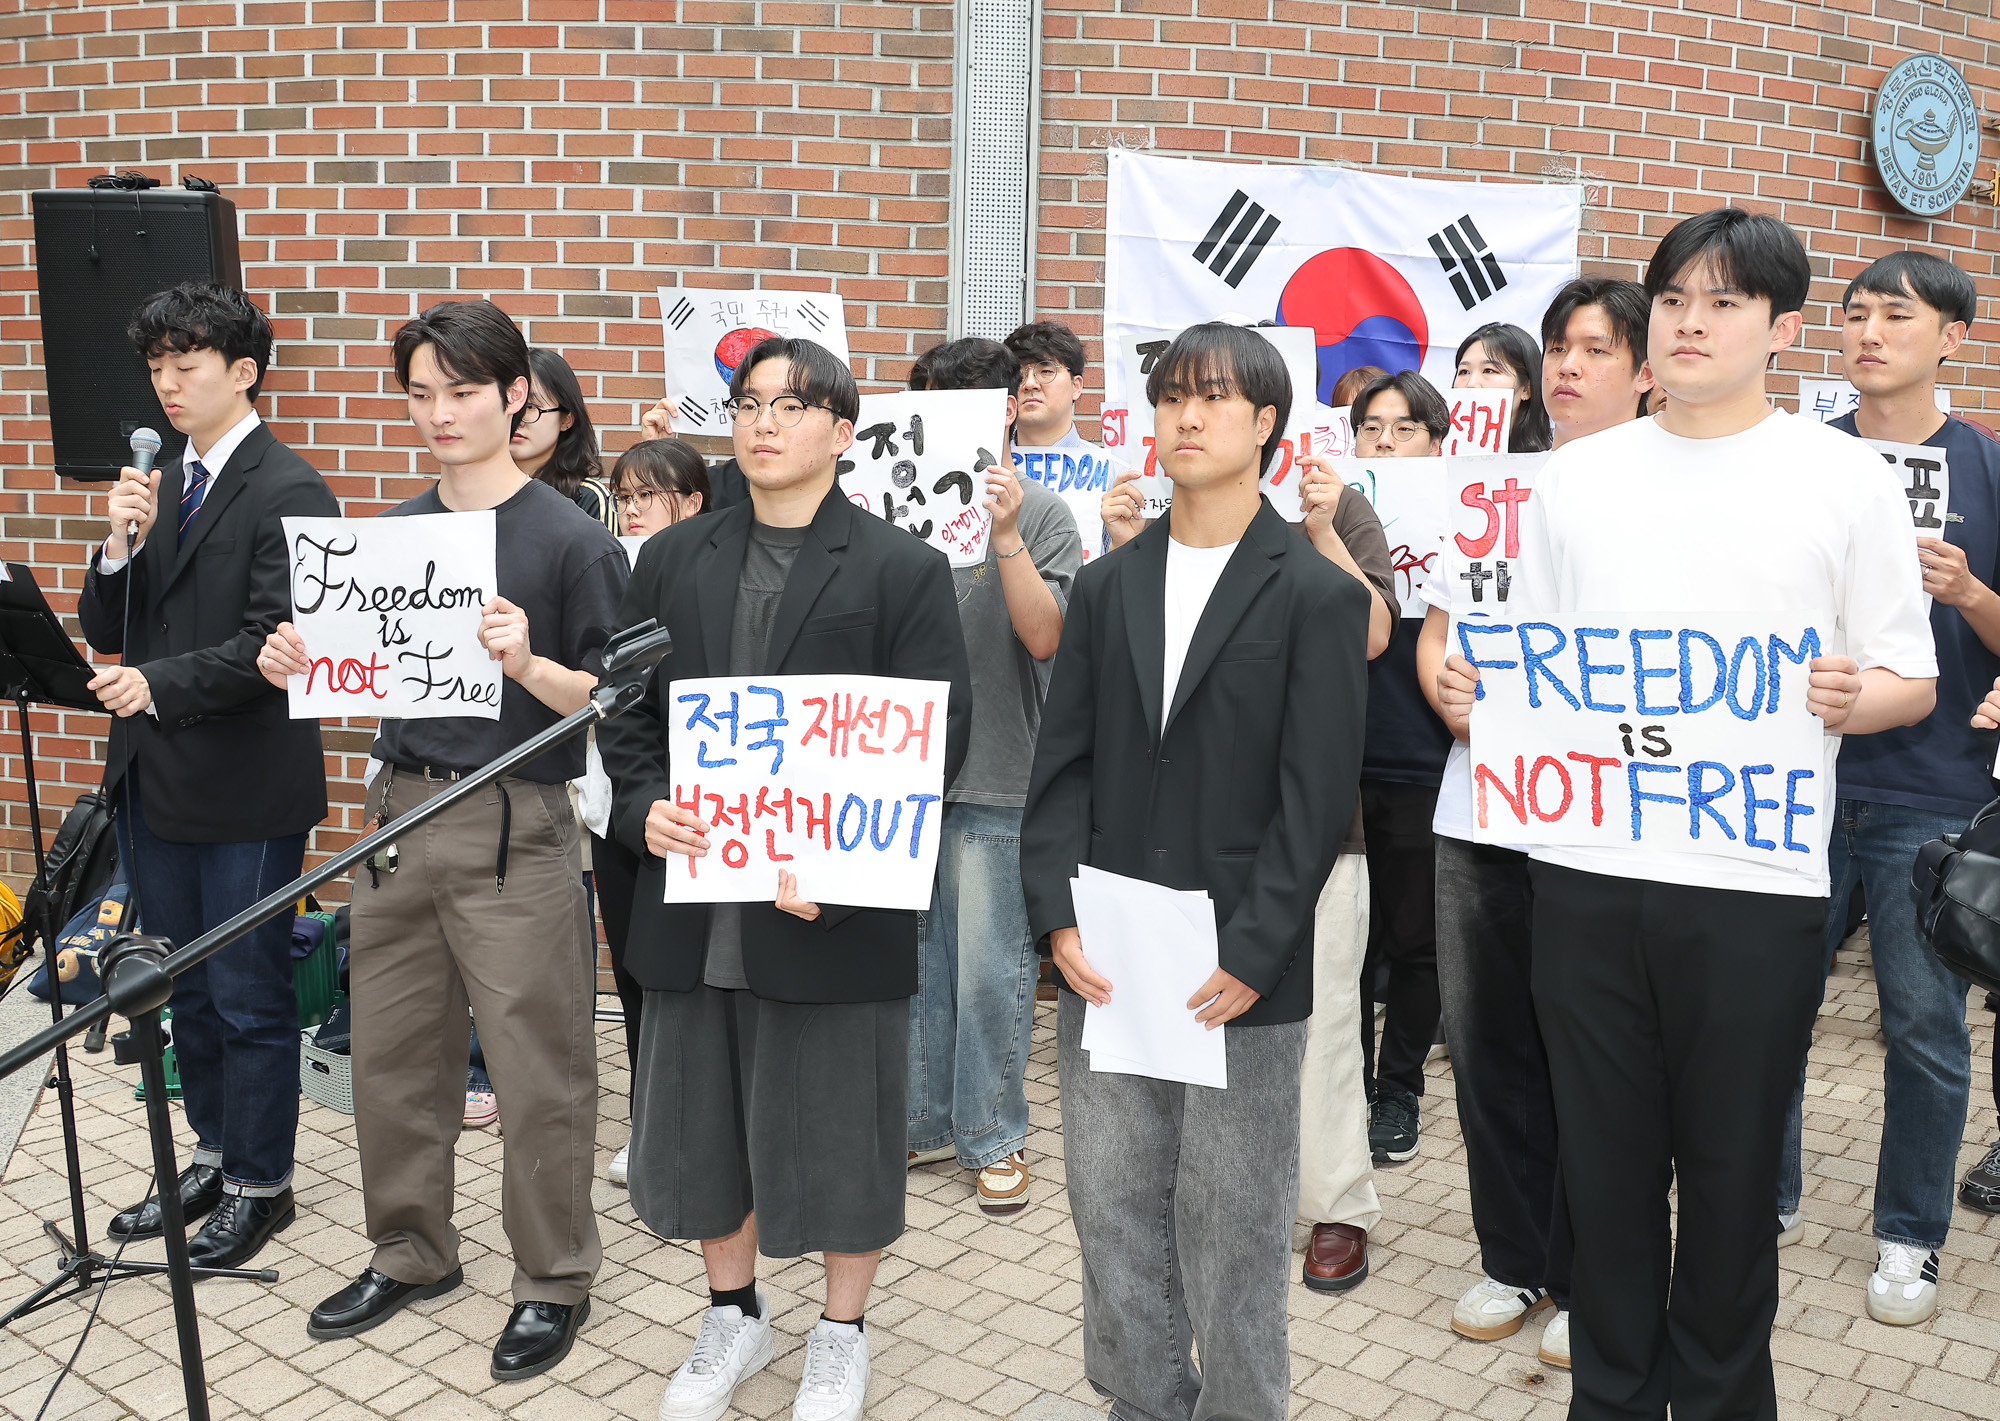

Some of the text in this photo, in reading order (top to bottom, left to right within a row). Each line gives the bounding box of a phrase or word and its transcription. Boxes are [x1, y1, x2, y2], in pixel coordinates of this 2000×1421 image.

[1925, 86, 1949, 106] GLORIA
[1879, 146, 1907, 200] PIETAS
[1910, 192, 1925, 209] ET
[1928, 160, 1972, 209] SCIENTIA
[1911, 169, 1938, 187] 1901
[710, 300, 789, 329] 국민 주권
[1438, 398, 1507, 458] 선거
[294, 533, 485, 614] Freedom
[377, 614, 411, 647] is
[306, 641, 501, 707] not Free
[1456, 622, 1822, 721] FREEDOM
[677, 685, 934, 775] 전국 재선거
[1618, 723, 1672, 758] is
[1474, 751, 1815, 854] NOT FREE
